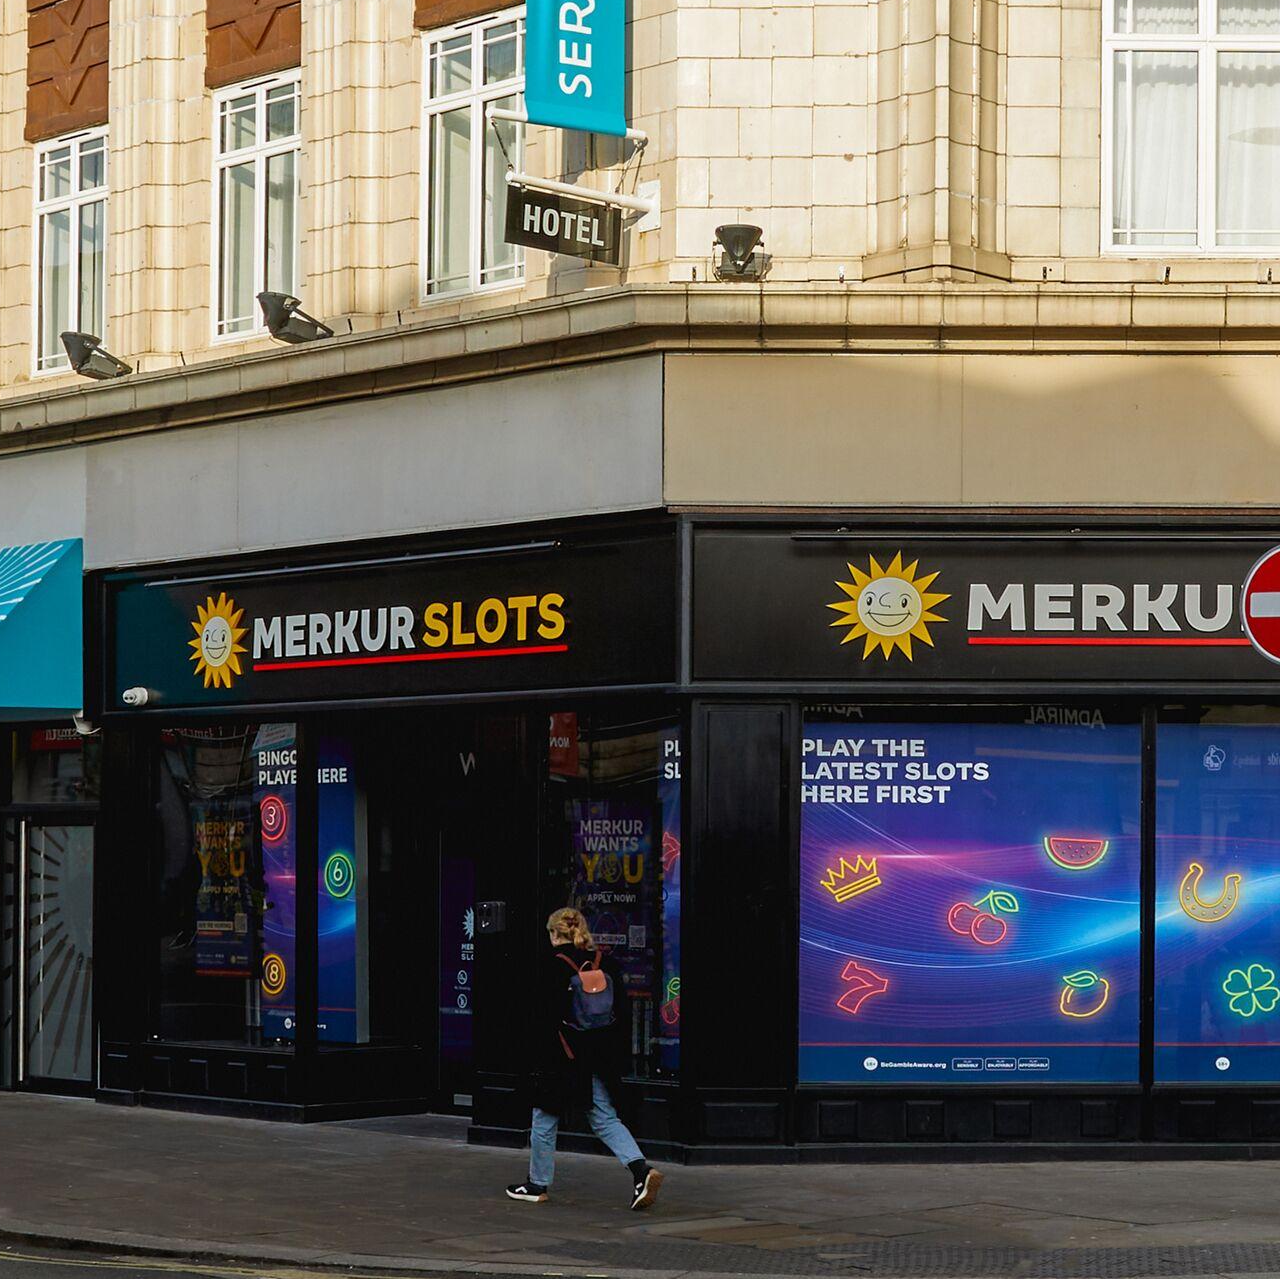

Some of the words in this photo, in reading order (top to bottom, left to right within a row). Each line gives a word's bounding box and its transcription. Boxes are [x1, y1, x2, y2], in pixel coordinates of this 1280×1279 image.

[523, 204, 604, 246] HOTEL
[967, 583, 1245, 632] MERKU
[253, 606, 416, 659] MERKUR
[422, 593, 565, 648] SLOTS
[802, 739, 865, 757] PLAY
[872, 739, 925, 757] THE
[258, 769, 297, 785] PLAYE
[801, 762, 898, 780] LATEST
[905, 762, 989, 781] SLOTS
[800, 785, 869, 803] HERE
[876, 785, 951, 803] FIRST
[266, 806, 276, 826] 3
[580, 820, 644, 835] MERKUR
[584, 837, 639, 852] WANTS
[333, 862, 343, 882] 6
[269, 963, 279, 982] 8
[880, 1061, 947, 1069] BeGambleAware.org
